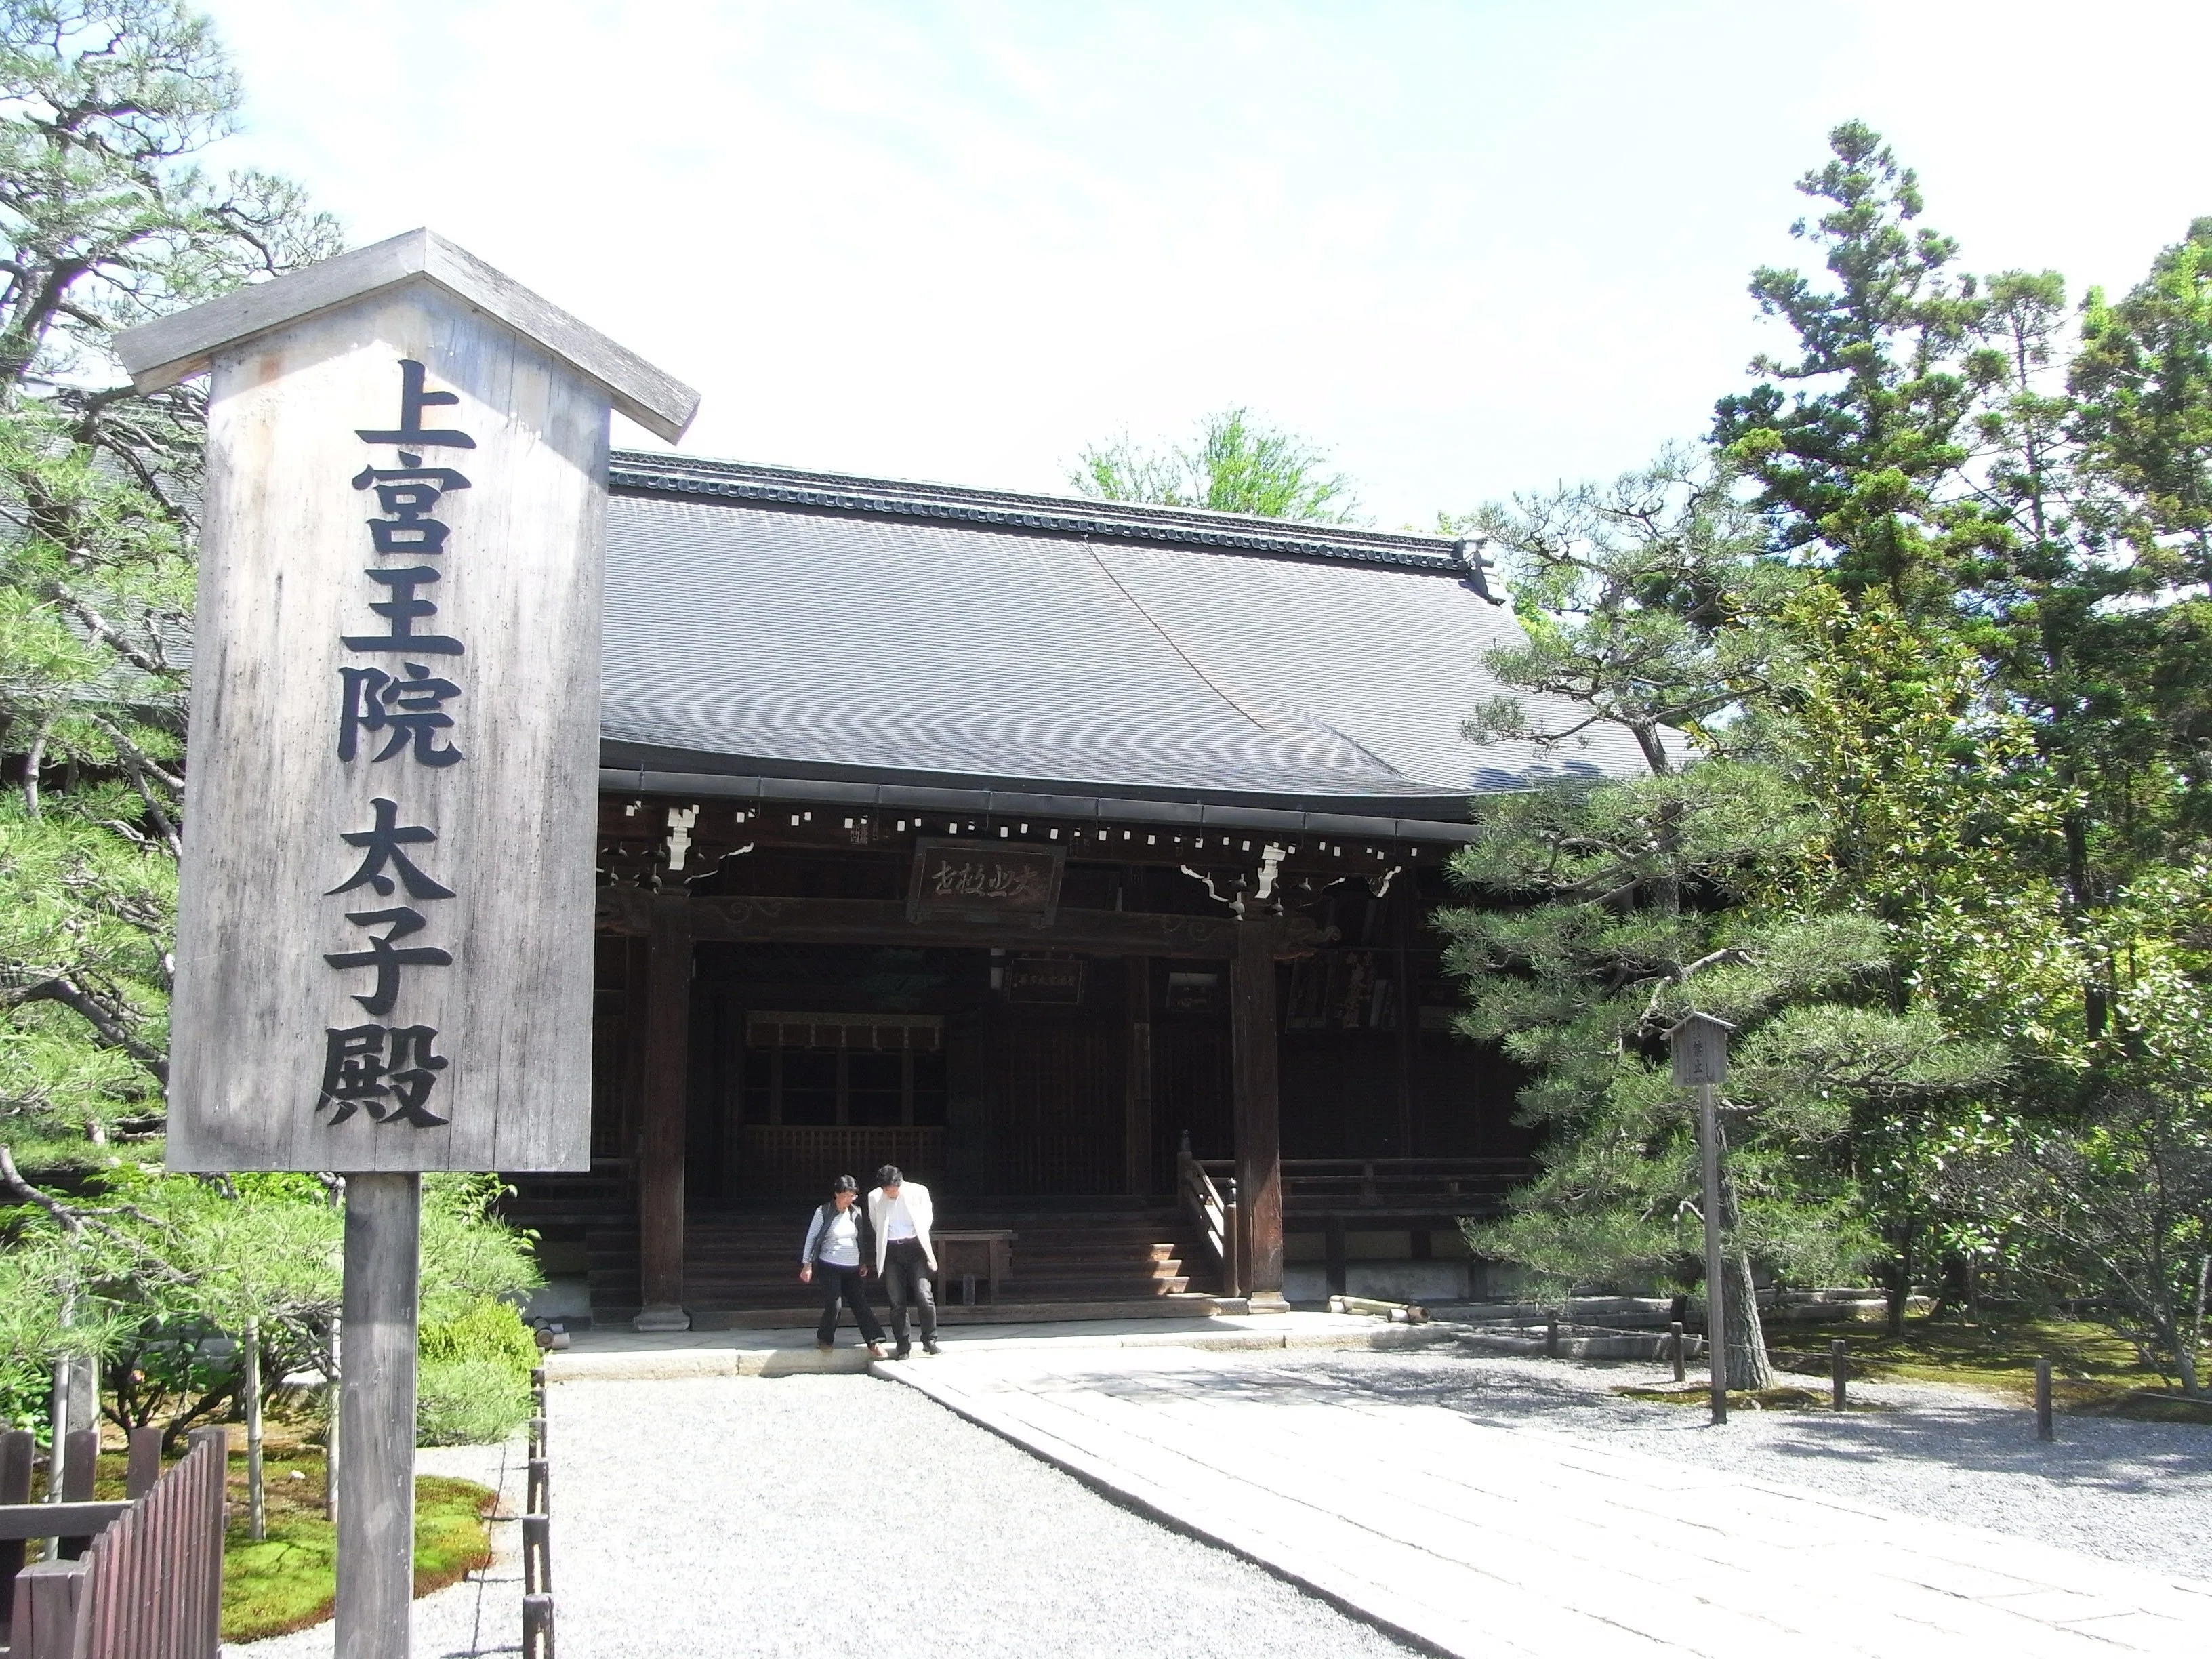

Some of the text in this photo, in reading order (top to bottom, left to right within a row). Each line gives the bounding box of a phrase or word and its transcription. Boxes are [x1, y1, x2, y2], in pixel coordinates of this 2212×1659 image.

[316, 359, 477, 1128] 上宮王院太子殿
